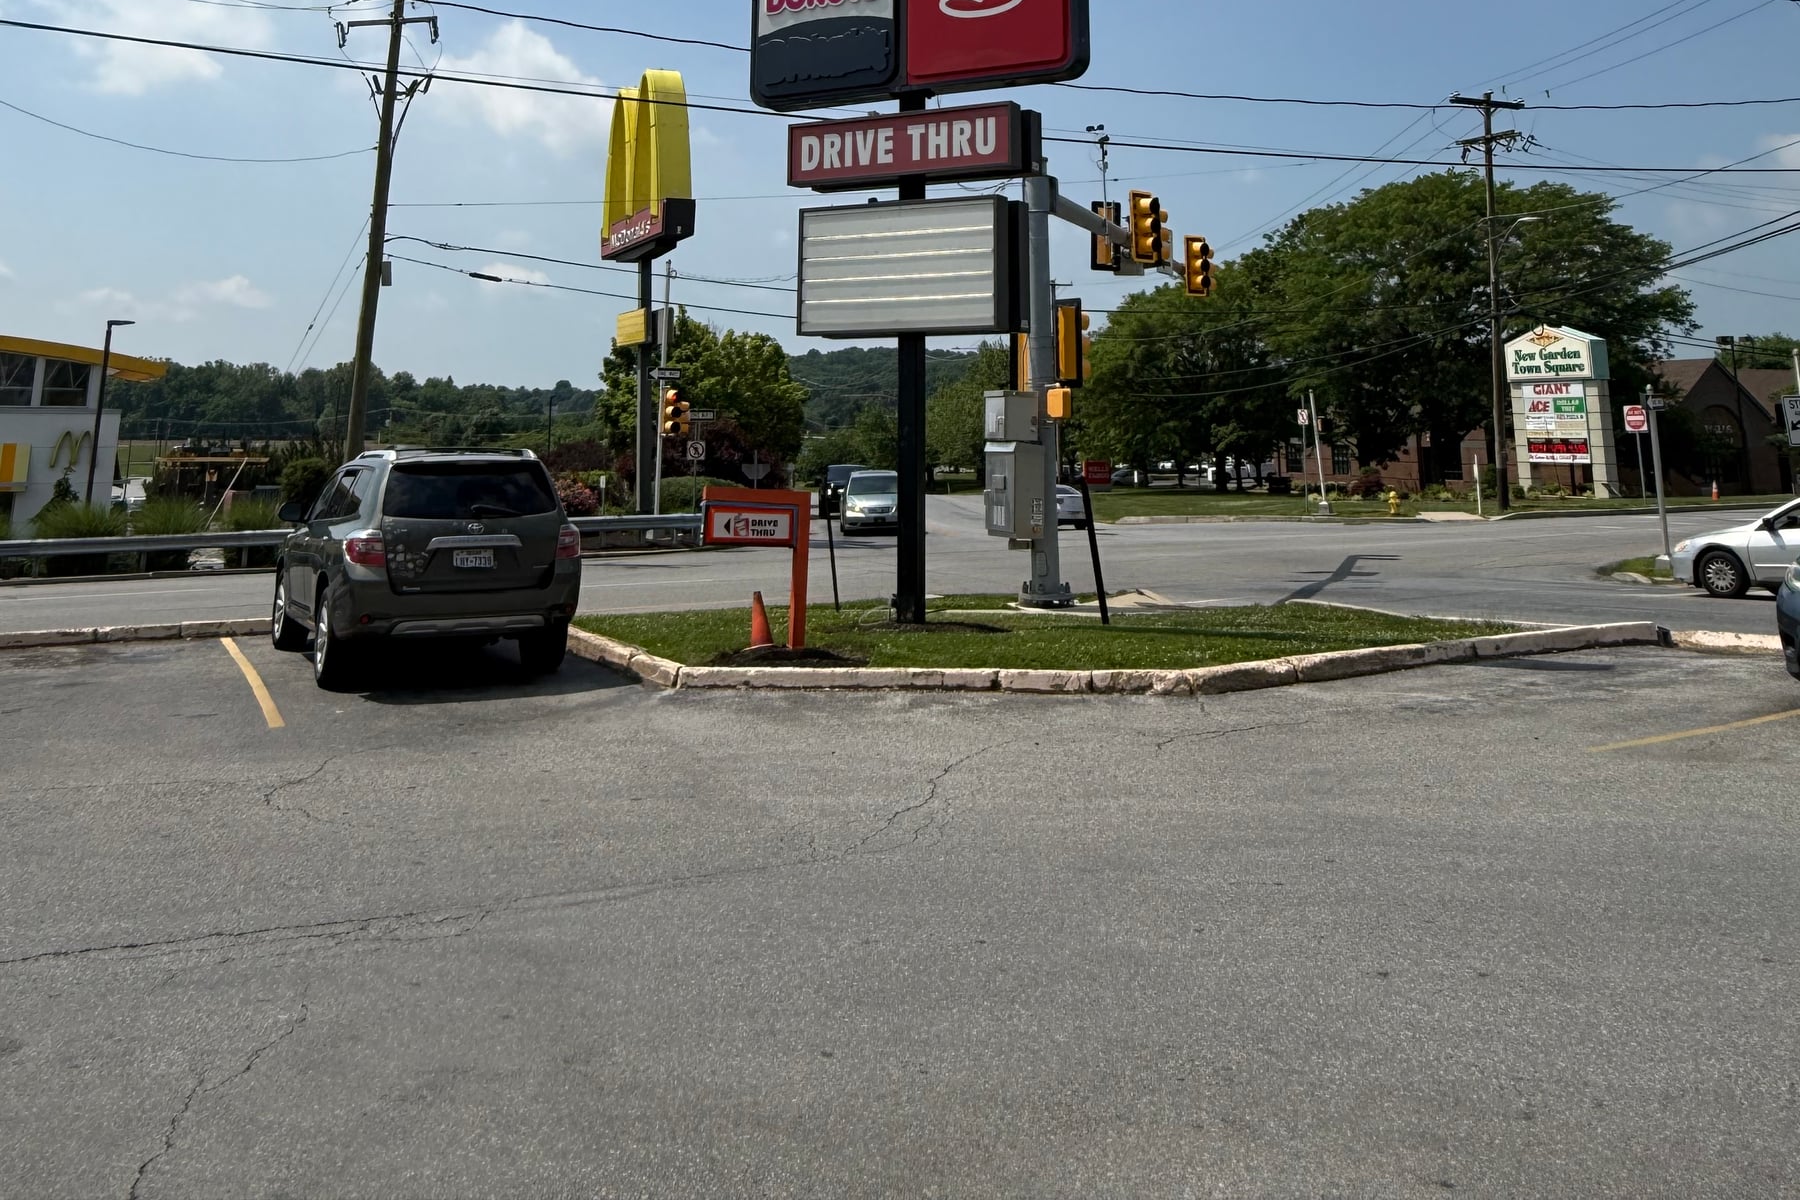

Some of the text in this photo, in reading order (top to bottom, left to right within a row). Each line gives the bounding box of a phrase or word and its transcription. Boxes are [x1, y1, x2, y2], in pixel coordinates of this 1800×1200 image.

[801, 116, 996, 171] DRIVE THRU
[1514, 347, 1581, 362] New Garden
[1512, 361, 1585, 376] Town Square
[1533, 383, 1571, 395] GIANT
[1529, 400, 1550, 412] ACE
[751, 519, 778, 527] DRIVE
[750, 528, 775, 536] THRU
